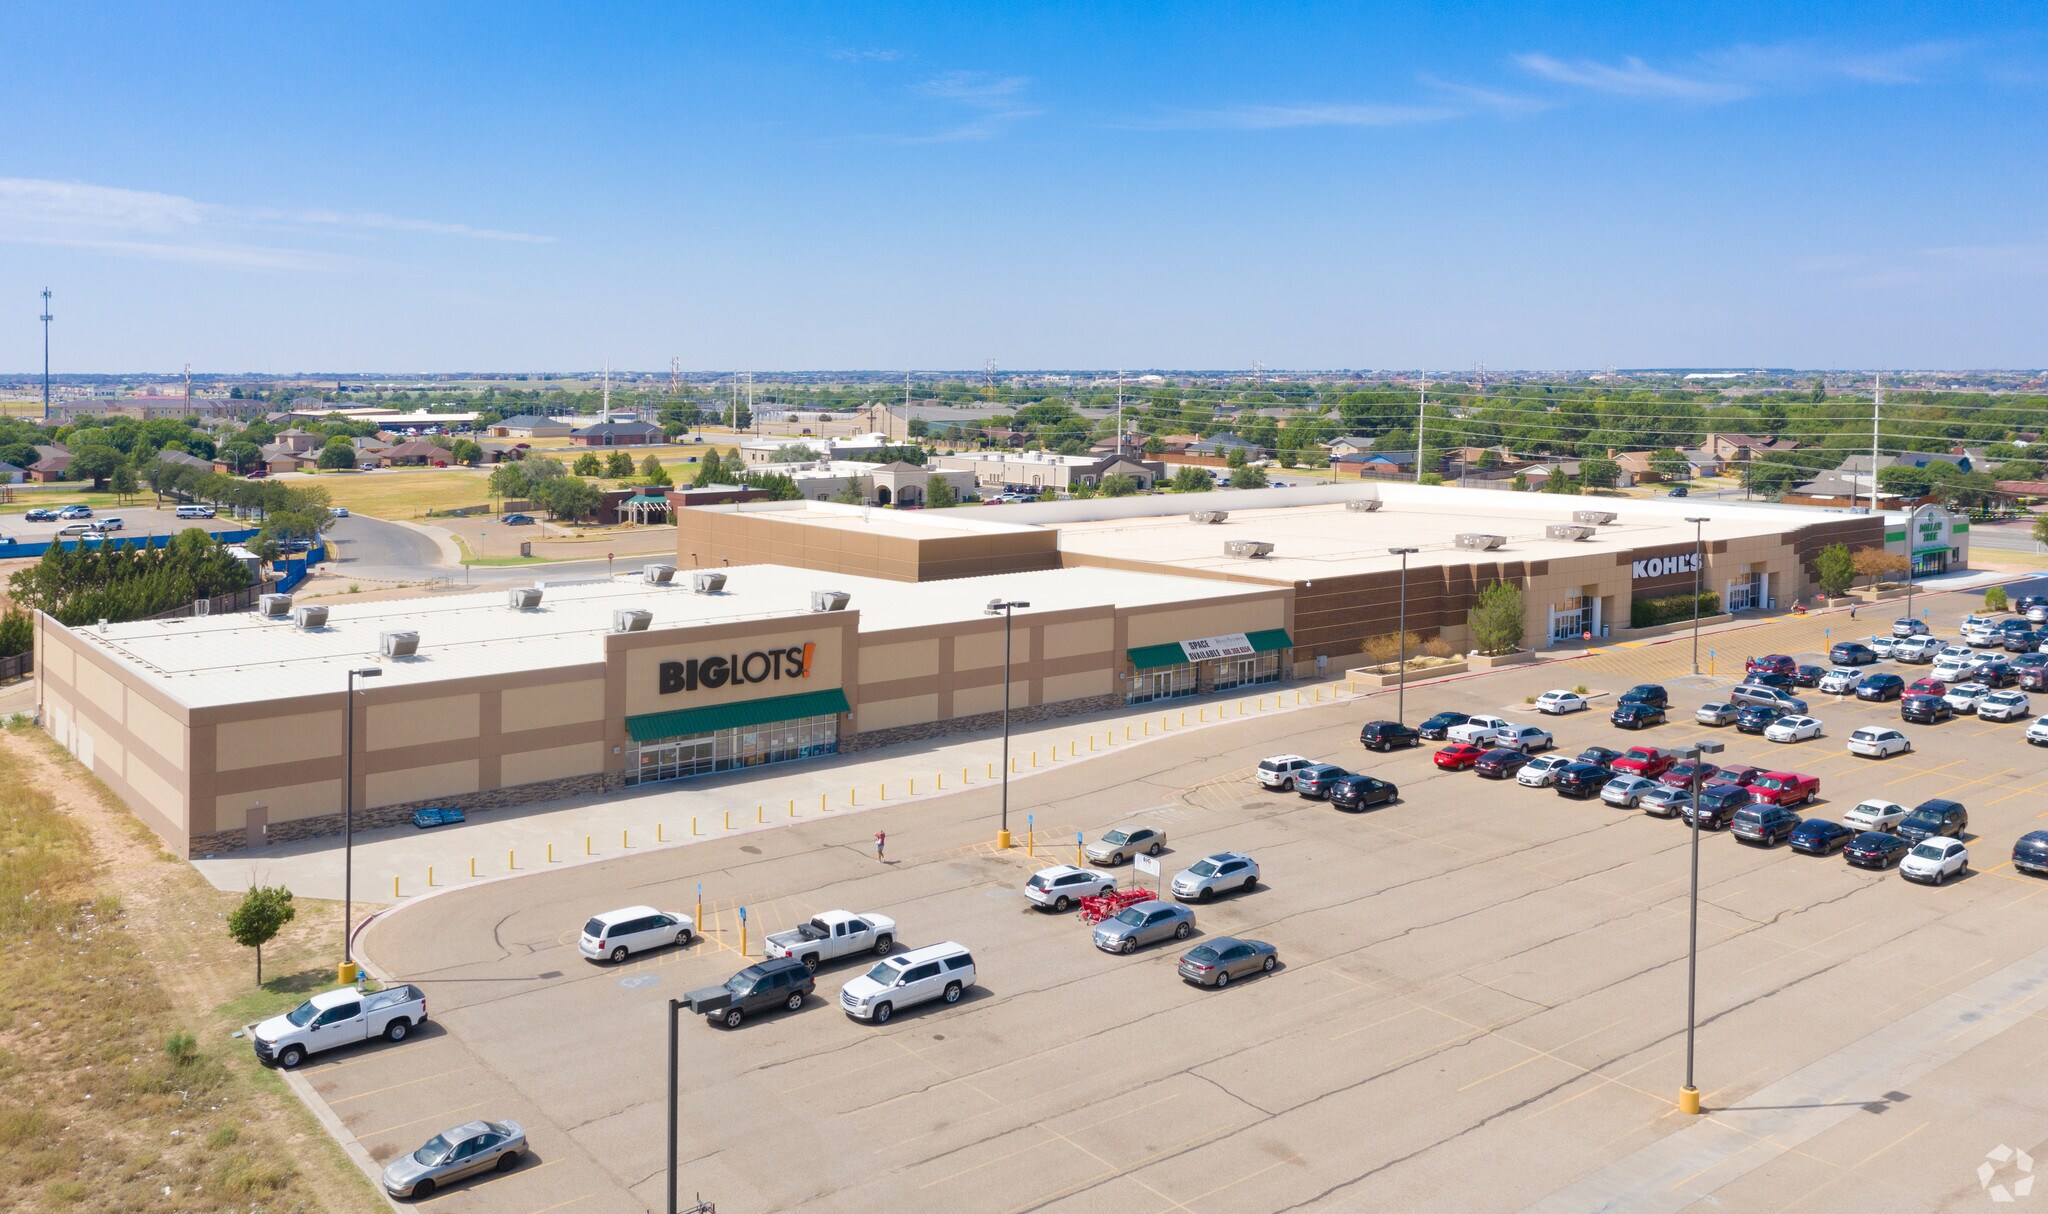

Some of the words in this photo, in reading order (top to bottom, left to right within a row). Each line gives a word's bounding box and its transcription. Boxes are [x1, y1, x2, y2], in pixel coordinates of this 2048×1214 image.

[1632, 553, 1702, 579] KOHL'S
[1188, 640, 1209, 650] SPACE
[1189, 649, 1221, 660] AVAILABLE
